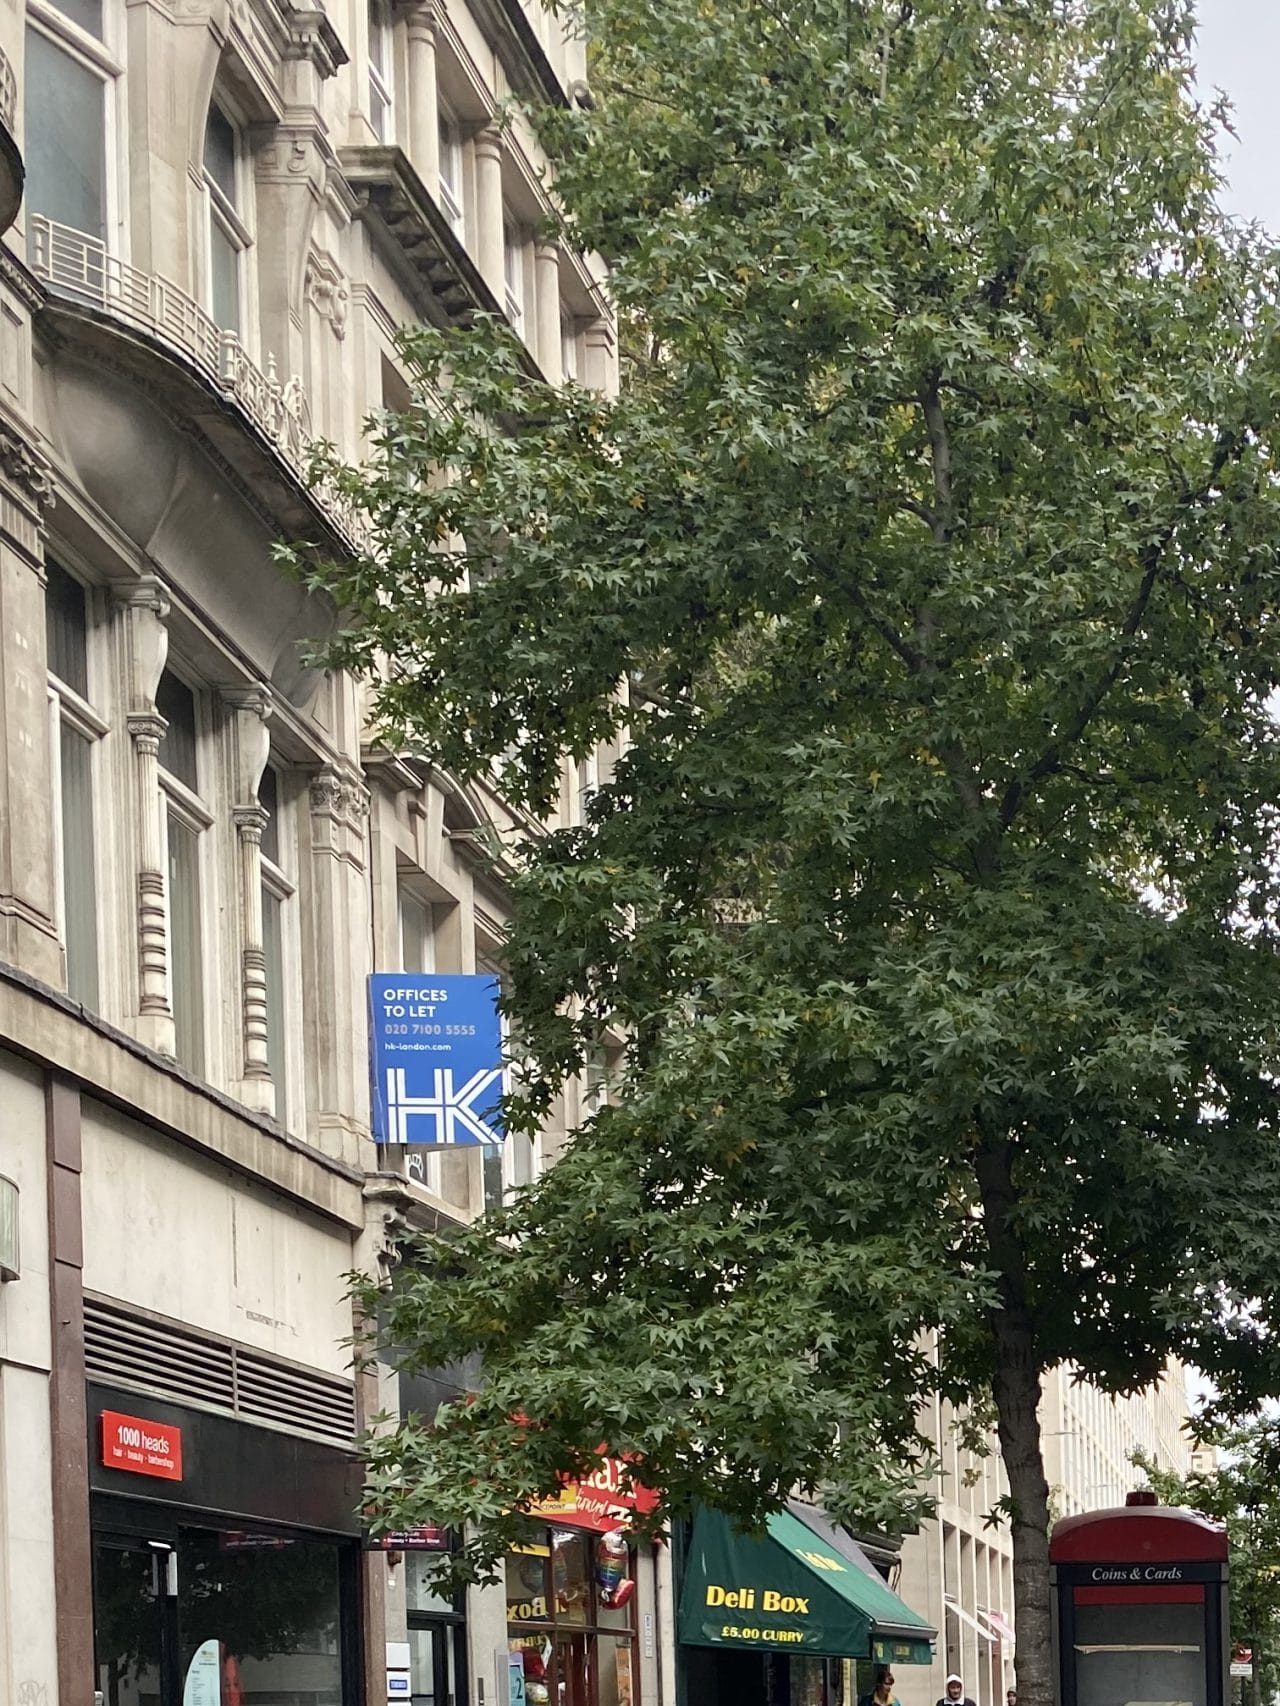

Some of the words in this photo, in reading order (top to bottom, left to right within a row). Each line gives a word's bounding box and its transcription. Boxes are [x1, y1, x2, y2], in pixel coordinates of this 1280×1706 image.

[383, 989, 448, 1001] OFFICES
[383, 1005, 405, 1018] TO
[409, 1005, 436, 1018] LET
[385, 1024, 408, 1035] 020
[412, 1024, 442, 1035] 7100
[445, 1025, 476, 1036] 5555
[385, 1042, 452, 1052] hk-london.com
[386, 1068, 504, 1144] HK
[117, 1425, 141, 1448] 1000
[141, 1431, 170, 1454] heads
[1091, 1567, 1128, 1581] Coins
[1129, 1567, 1142, 1580] &
[1144, 1566, 1183, 1580] Cards
[705, 1585, 755, 1610] Deli
[762, 1590, 810, 1614] Box
[762, 1628, 804, 1643] CURRY
